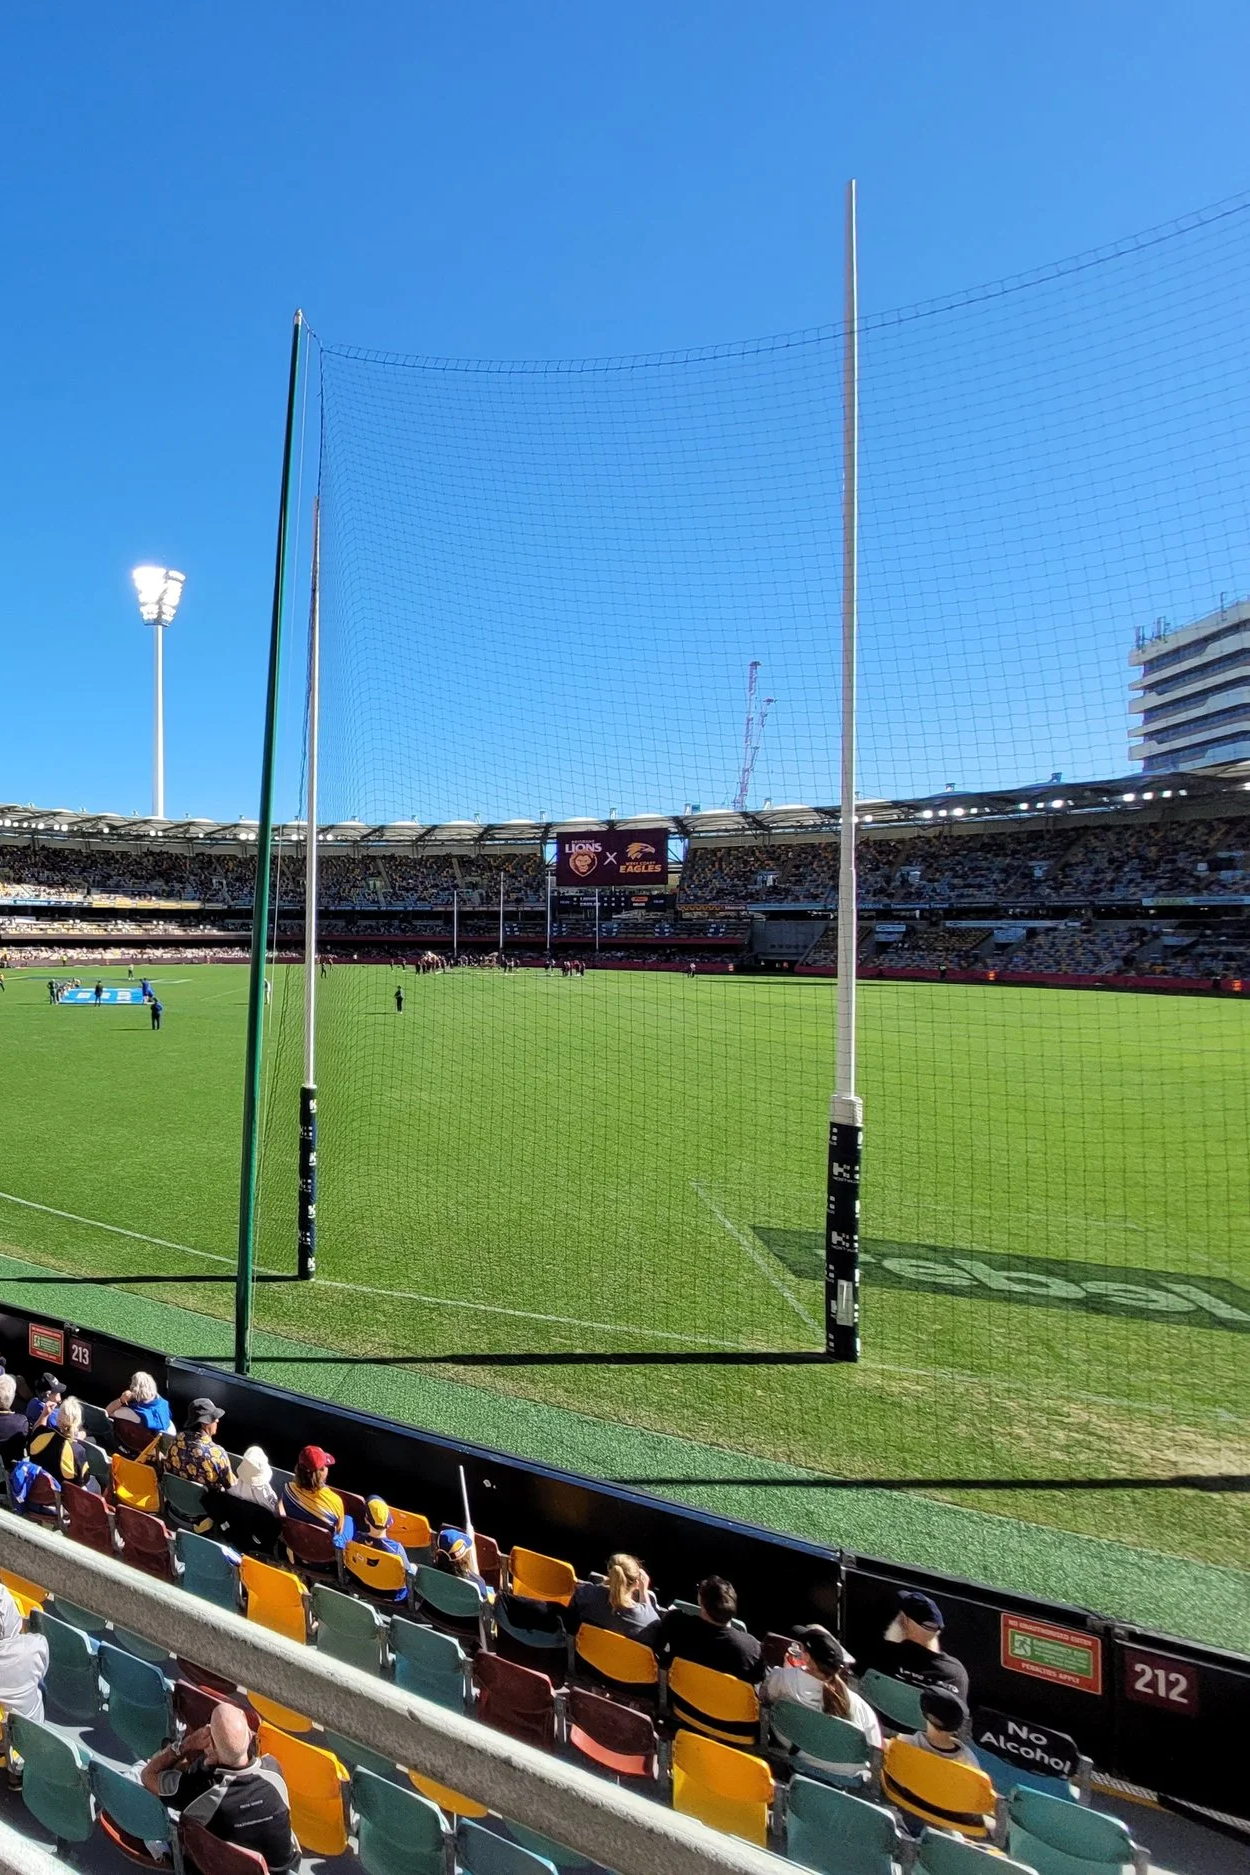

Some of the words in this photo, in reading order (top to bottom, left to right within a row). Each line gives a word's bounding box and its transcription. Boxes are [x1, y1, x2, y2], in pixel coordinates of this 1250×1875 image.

[565, 843, 602, 853] LIONS
[619, 864, 662, 873] EAGLES
[72, 1344, 90, 1365] 213
[1134, 1663, 1189, 1704] 212
[1007, 1721, 1048, 1746] No
[979, 1731, 1072, 1774] Alcohol
